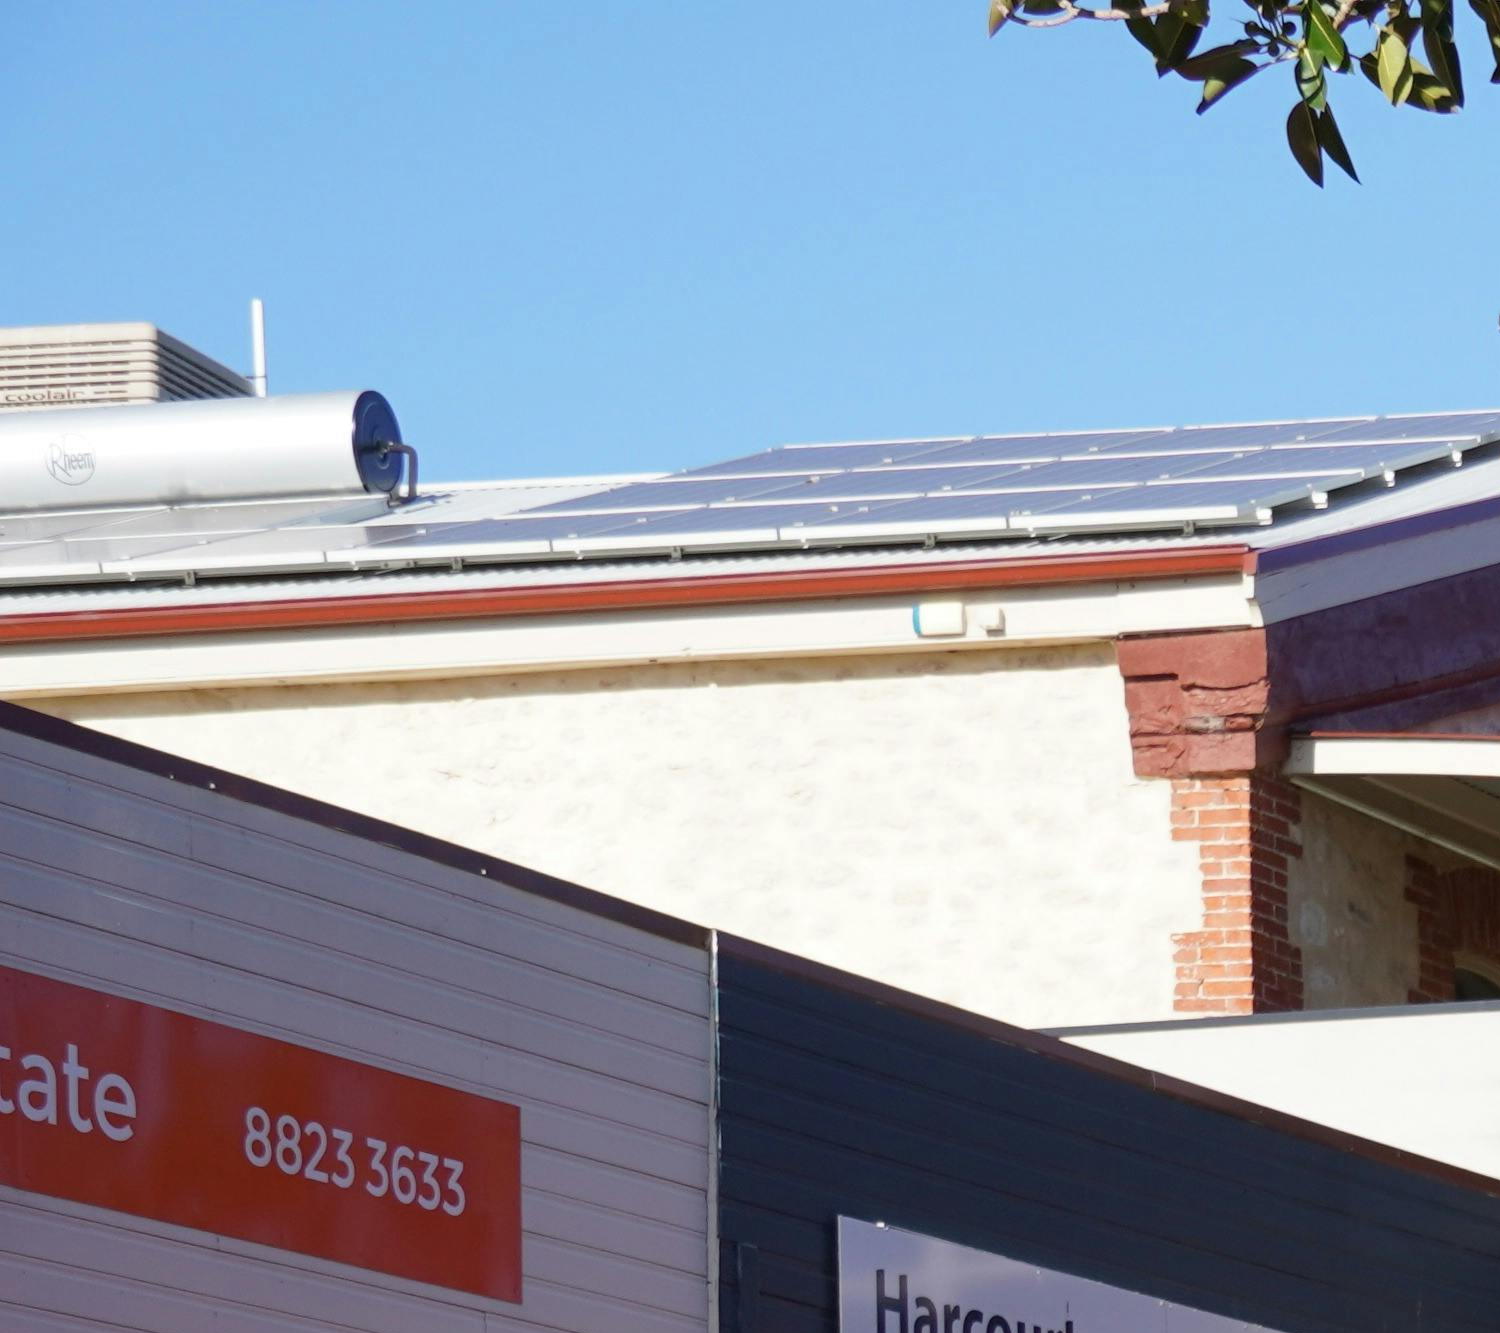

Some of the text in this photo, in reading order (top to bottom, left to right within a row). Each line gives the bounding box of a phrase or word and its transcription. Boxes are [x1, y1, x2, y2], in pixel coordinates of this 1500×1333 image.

[49, 436, 95, 477] Rheem
[245, 1106, 466, 1216] 8823 3633
